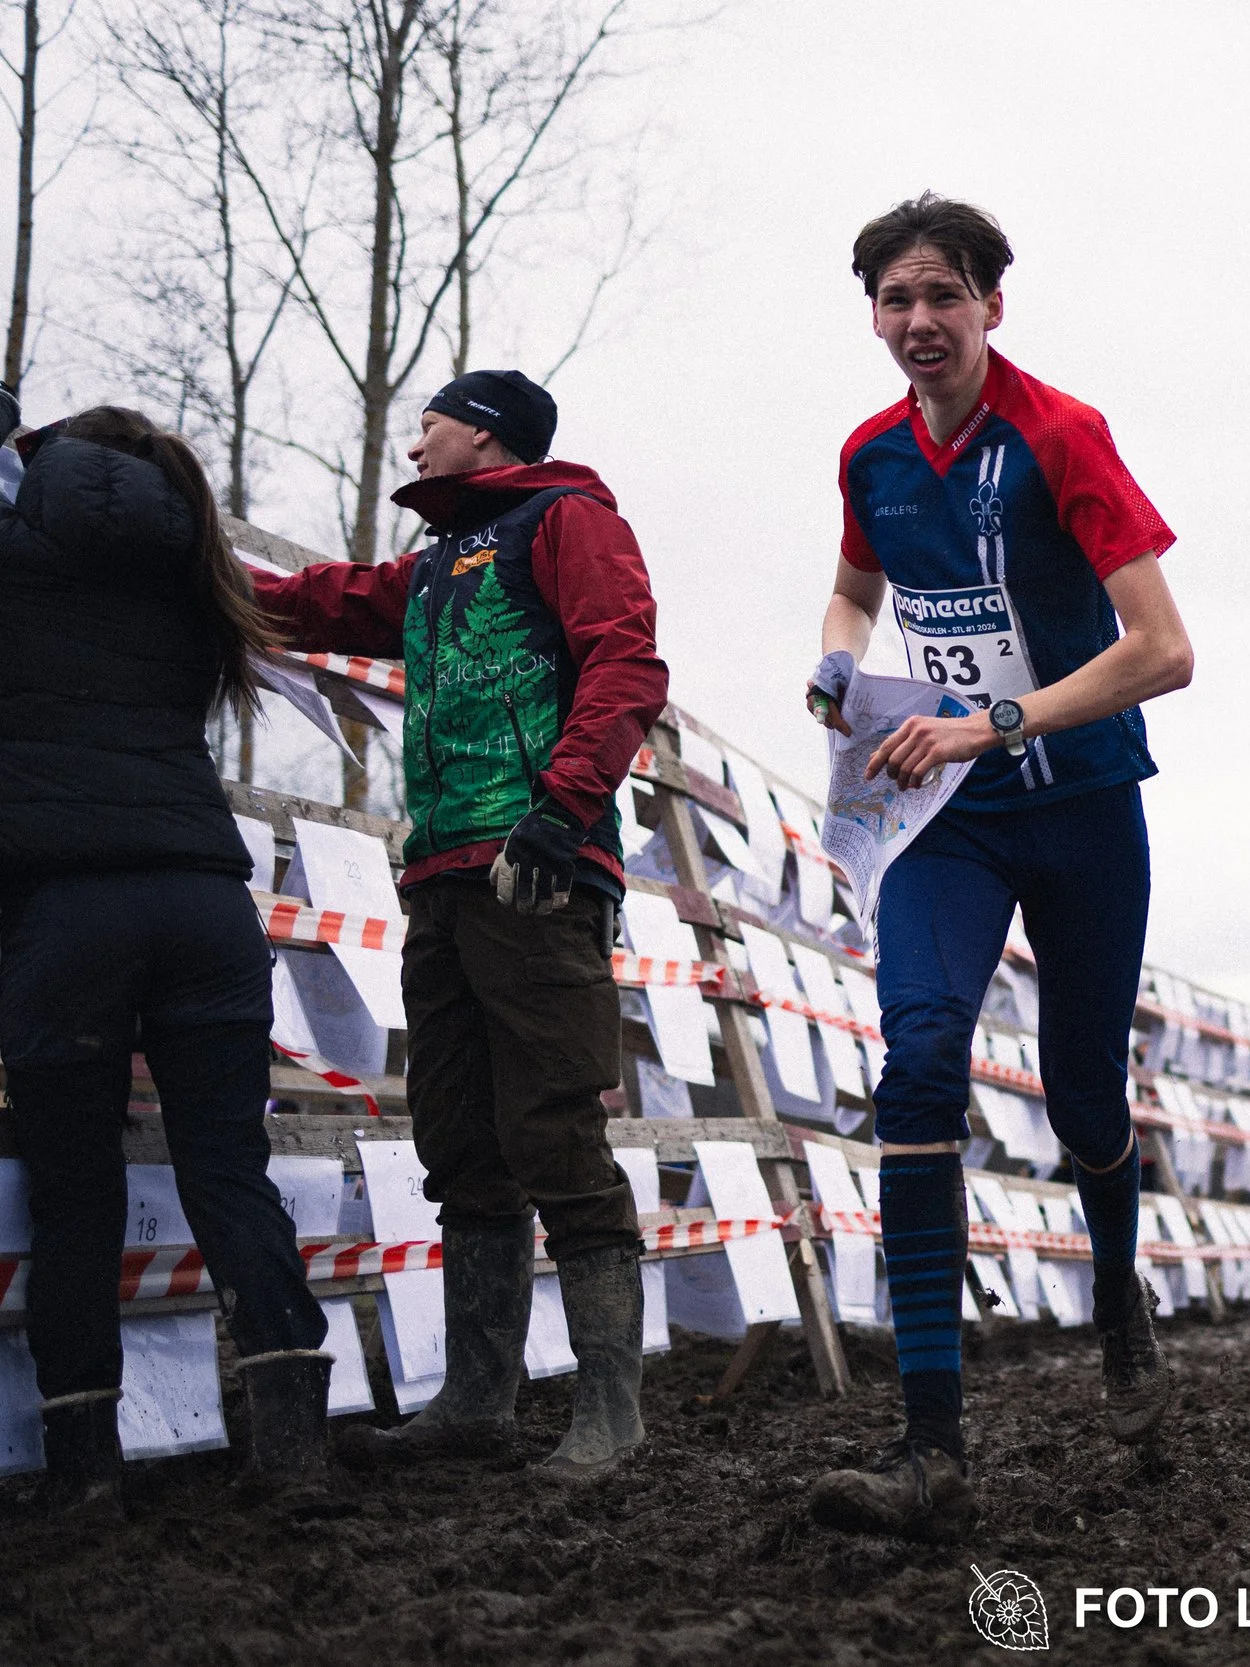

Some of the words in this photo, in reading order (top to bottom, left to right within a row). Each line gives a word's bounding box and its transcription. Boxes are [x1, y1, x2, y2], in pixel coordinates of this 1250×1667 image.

[467, 400, 501, 418] TRIMTEX
[951, 402, 990, 451] noname
[894, 587, 1006, 622] bagheera
[951, 626, 966, 634] STL
[965, 624, 976, 633] #1
[976, 622, 997, 632] 2026
[996, 638, 1013, 657] 2
[922, 644, 981, 686] 63
[137, 1217, 158, 1242] 18
